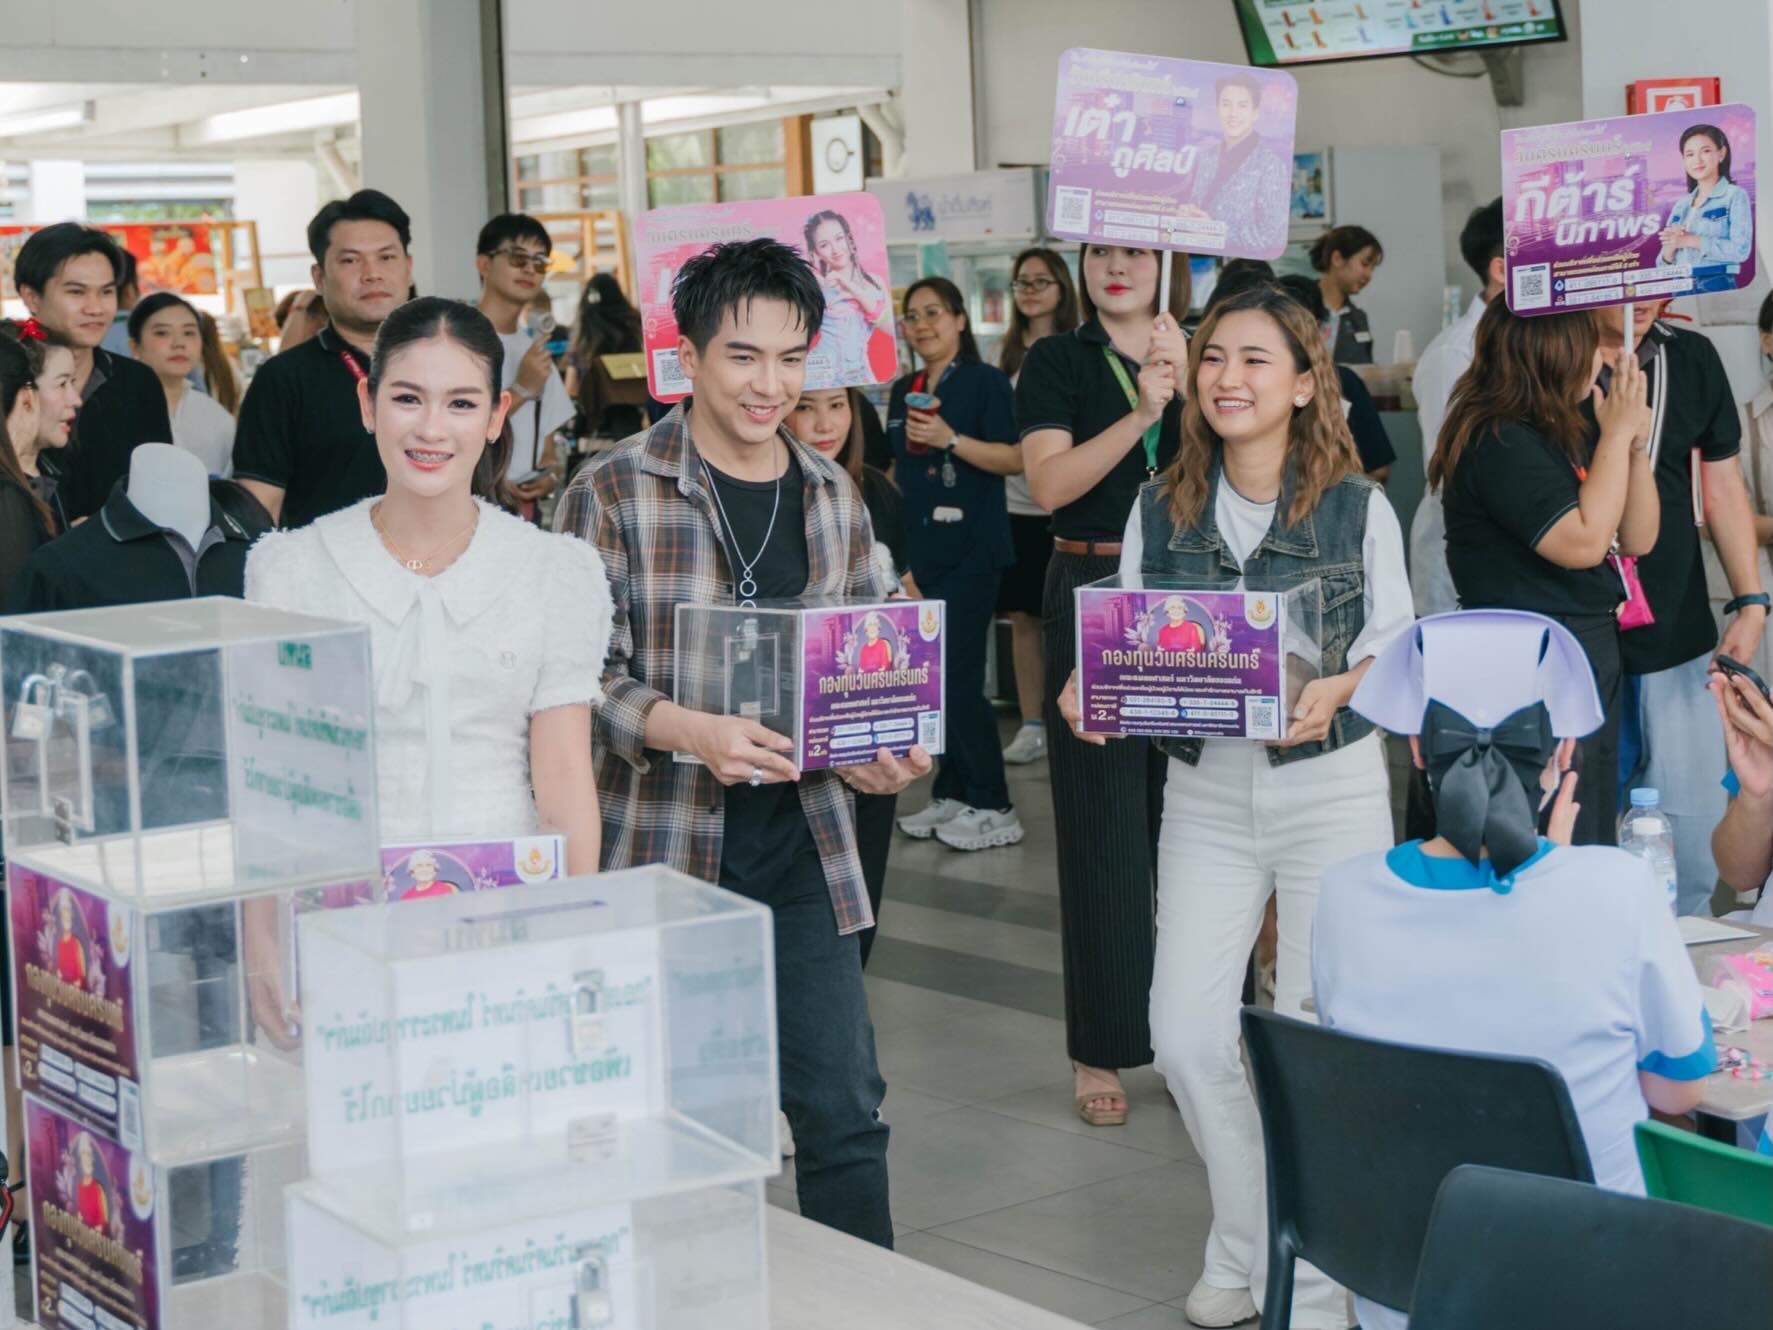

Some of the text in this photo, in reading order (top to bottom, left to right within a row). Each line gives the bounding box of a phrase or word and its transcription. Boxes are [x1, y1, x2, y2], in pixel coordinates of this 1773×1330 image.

[1063, 93, 1137, 143] เต๋า
[1514, 164, 1640, 222] กีต้าร์
[1101, 646, 1261, 673] กองทุนวันศรีนครินทร์
[819, 660, 930, 698] กองทุนวันศรีนครินทร์
[1097, 709, 1107, 721] 2
[813, 744, 821, 757] 2
